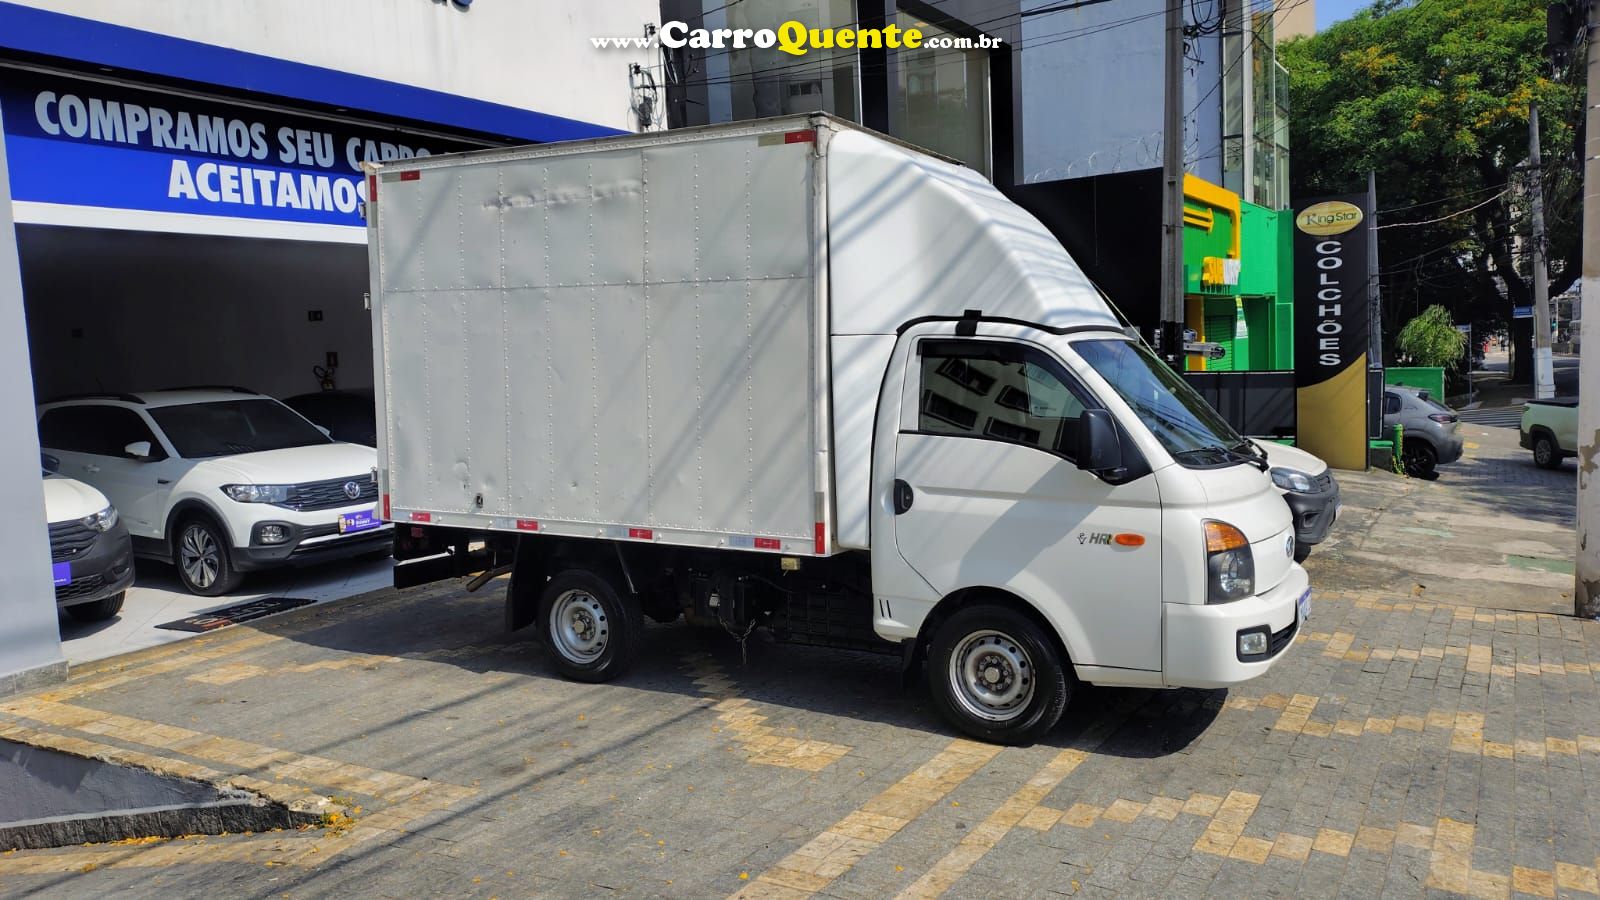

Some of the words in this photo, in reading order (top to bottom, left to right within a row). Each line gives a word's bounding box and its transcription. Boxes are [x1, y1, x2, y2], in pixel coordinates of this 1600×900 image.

[35, 90, 268, 160] COMPRAMOS
[277, 127, 334, 168] SEU
[346, 137, 430, 172] CAR
[1315, 241, 1343, 366] COLCHÕES
